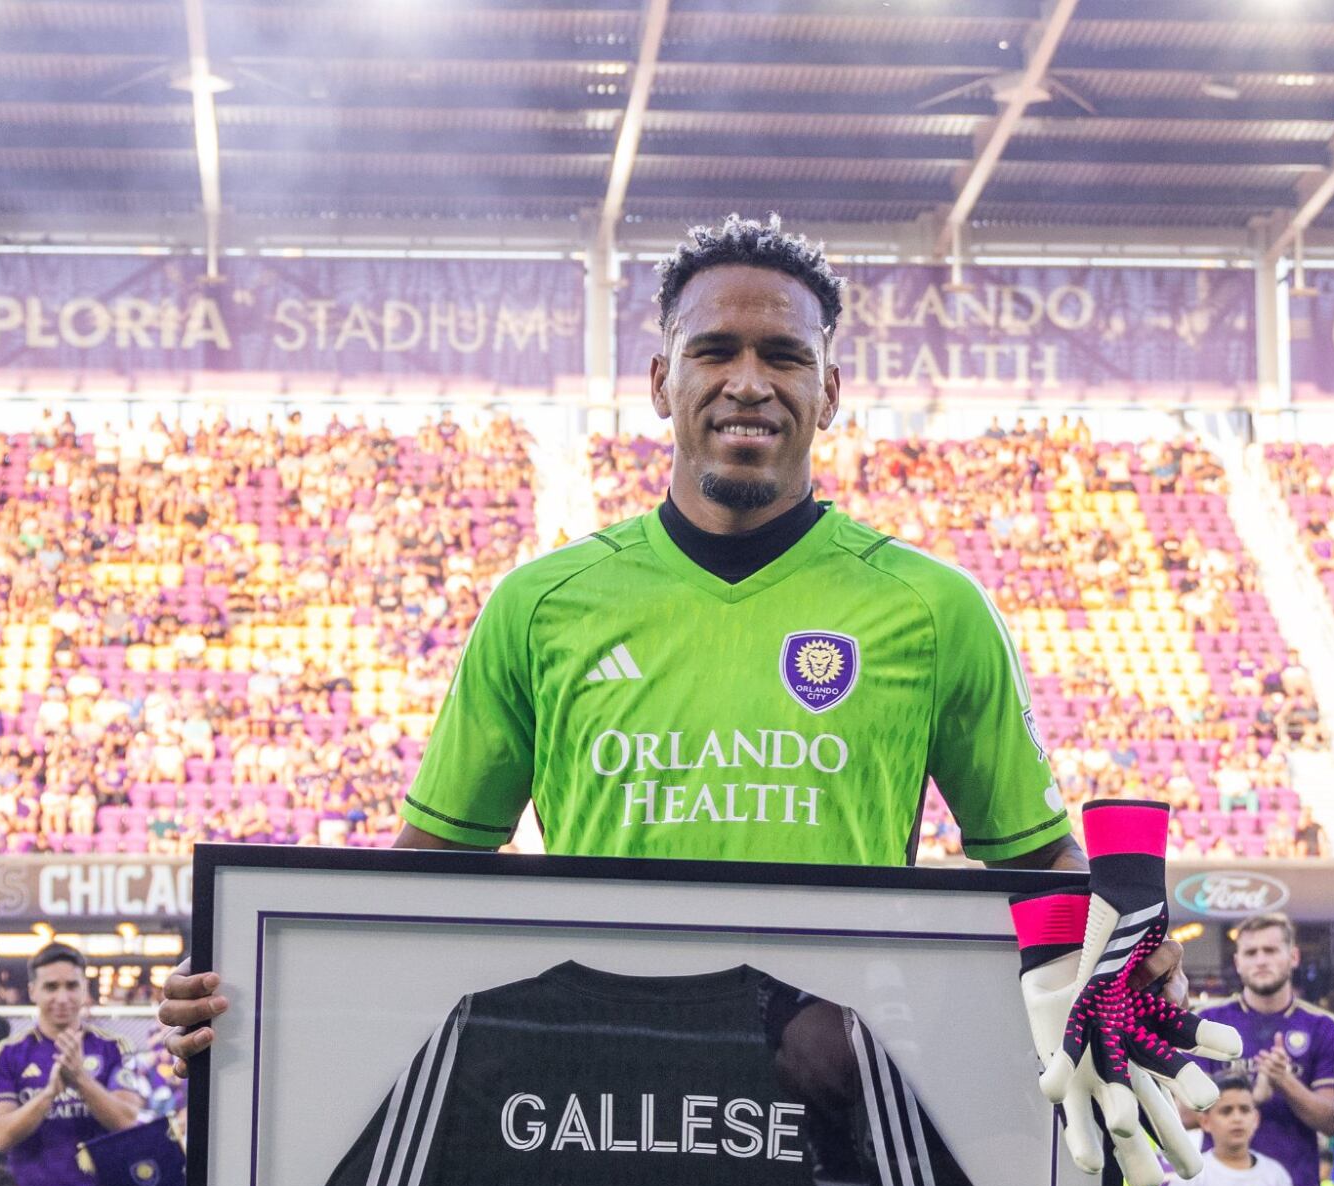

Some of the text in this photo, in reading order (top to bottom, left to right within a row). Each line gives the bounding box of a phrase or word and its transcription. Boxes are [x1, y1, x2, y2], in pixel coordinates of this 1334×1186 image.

[273, 300, 550, 354] STADIUM
[842, 282, 1095, 331] RLANDO
[796, 685, 839, 695] ORLANDO
[591, 728, 849, 777] ORLANDO
[619, 779, 821, 829] HEALTH
[1195, 877, 1270, 909] Ford
[500, 1092, 806, 1163] GALLESE
